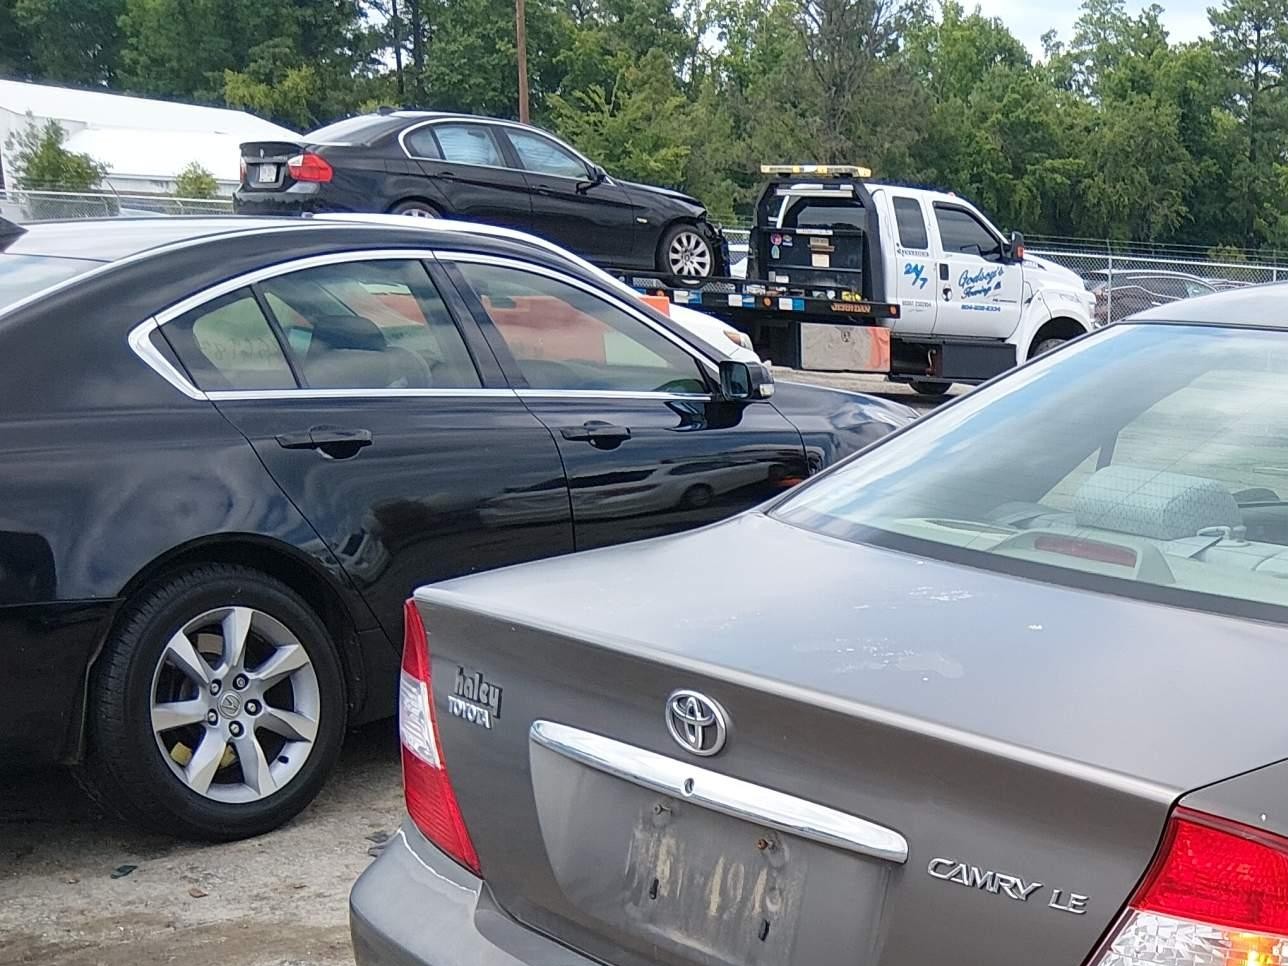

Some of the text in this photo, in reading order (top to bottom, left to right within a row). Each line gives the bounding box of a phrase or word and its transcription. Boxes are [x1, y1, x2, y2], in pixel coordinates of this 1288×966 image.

[448, 695, 491, 729] TOYOTA
[455, 666, 502, 719] haley
[928, 857, 1089, 914] CAMRY LE
